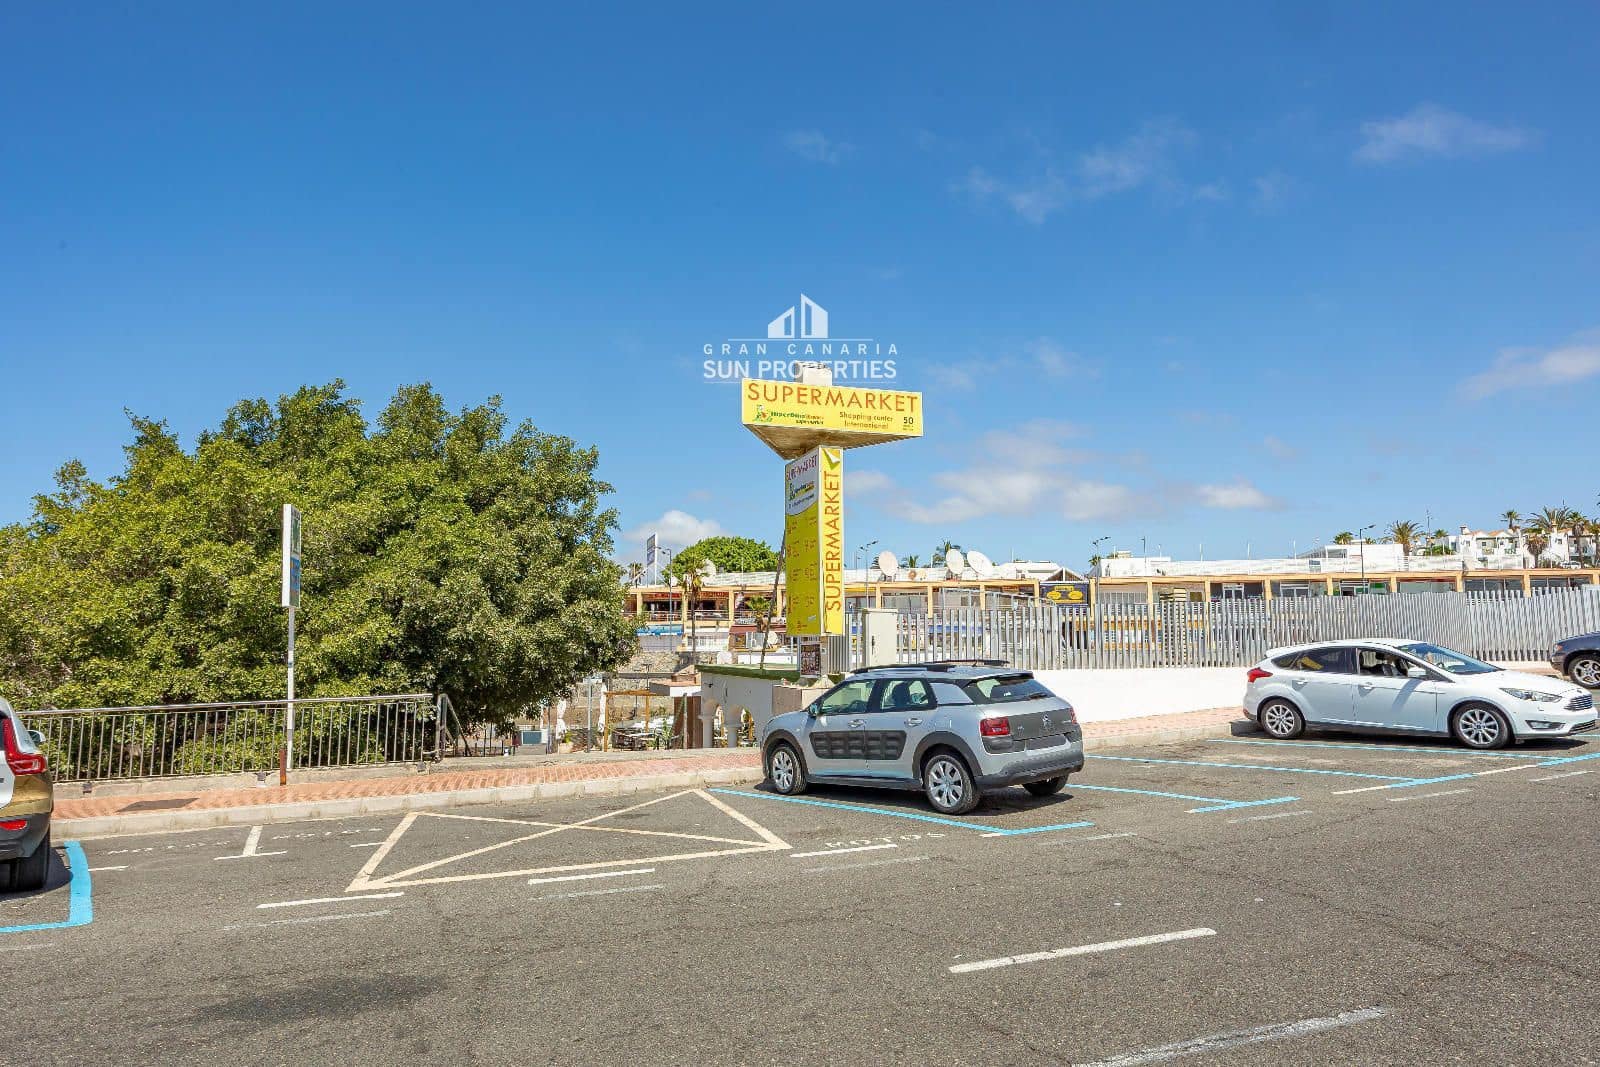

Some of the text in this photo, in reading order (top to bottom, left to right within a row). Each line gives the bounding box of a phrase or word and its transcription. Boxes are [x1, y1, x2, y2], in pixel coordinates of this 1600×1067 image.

[747, 382, 919, 413] SUPERMARKET
[839, 411, 872, 422] Shopping
[903, 416, 914, 425] 50
[824, 470, 841, 612] SUPERMARKET
